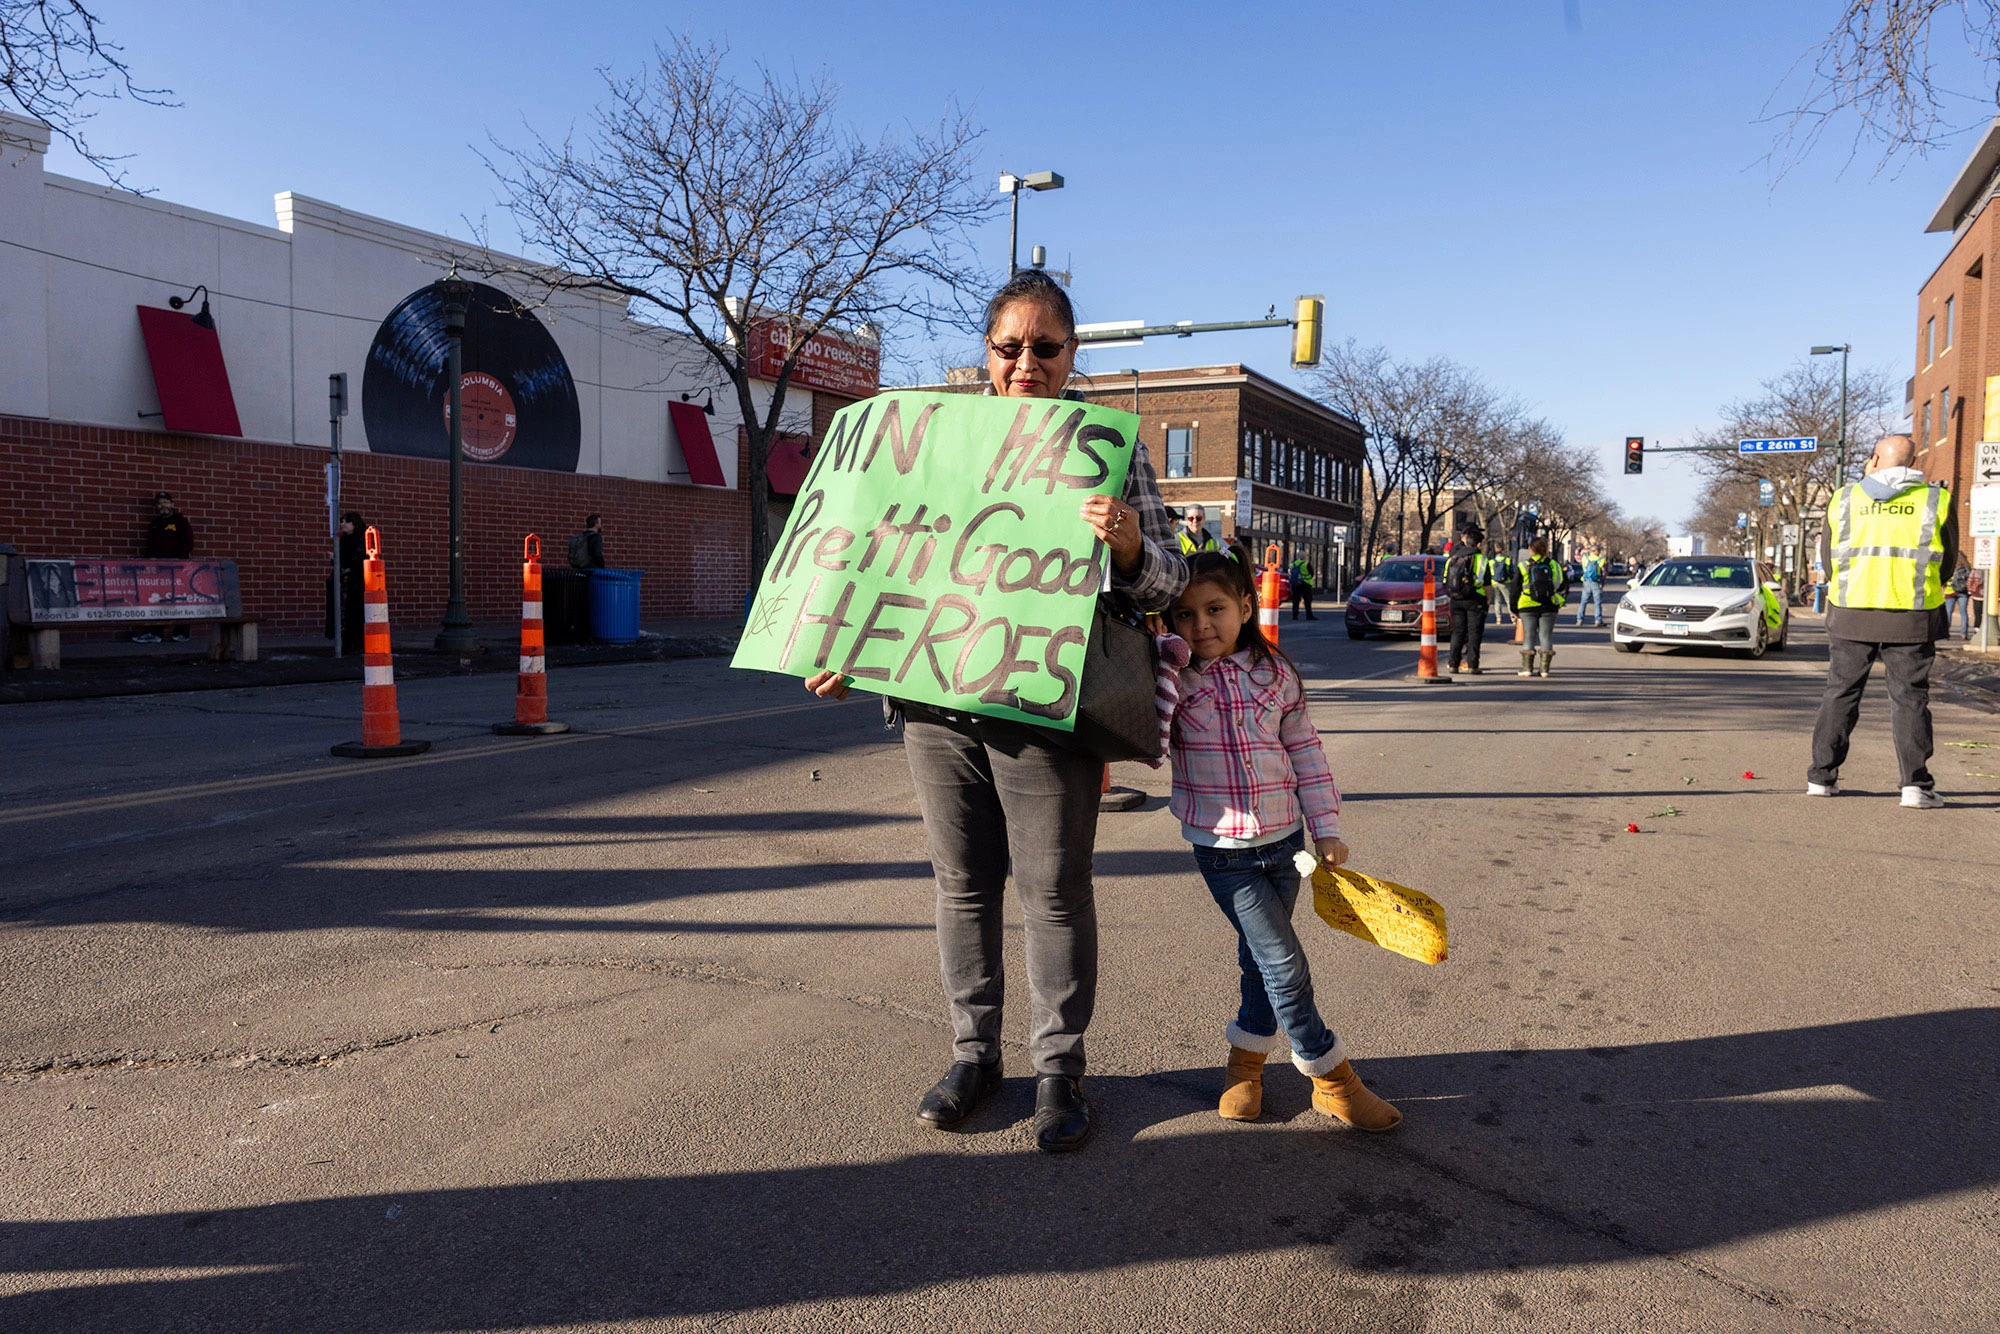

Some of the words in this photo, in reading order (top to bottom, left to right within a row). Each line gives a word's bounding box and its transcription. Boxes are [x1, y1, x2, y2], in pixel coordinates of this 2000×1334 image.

[805, 399, 944, 492] MN
[981, 403, 1126, 495] HAS
[1755, 441, 1764, 451] E
[1767, 441, 1797, 450] 26th
[1799, 440, 1814, 449] St
[1982, 445, 2000, 455] ON
[769, 489, 952, 585] Pretti
[949, 502, 1102, 596] Good
[34, 611, 62, 620] Moon
[86, 608, 146, 619] 612-870-0800
[779, 574, 1086, 721] HEROES
